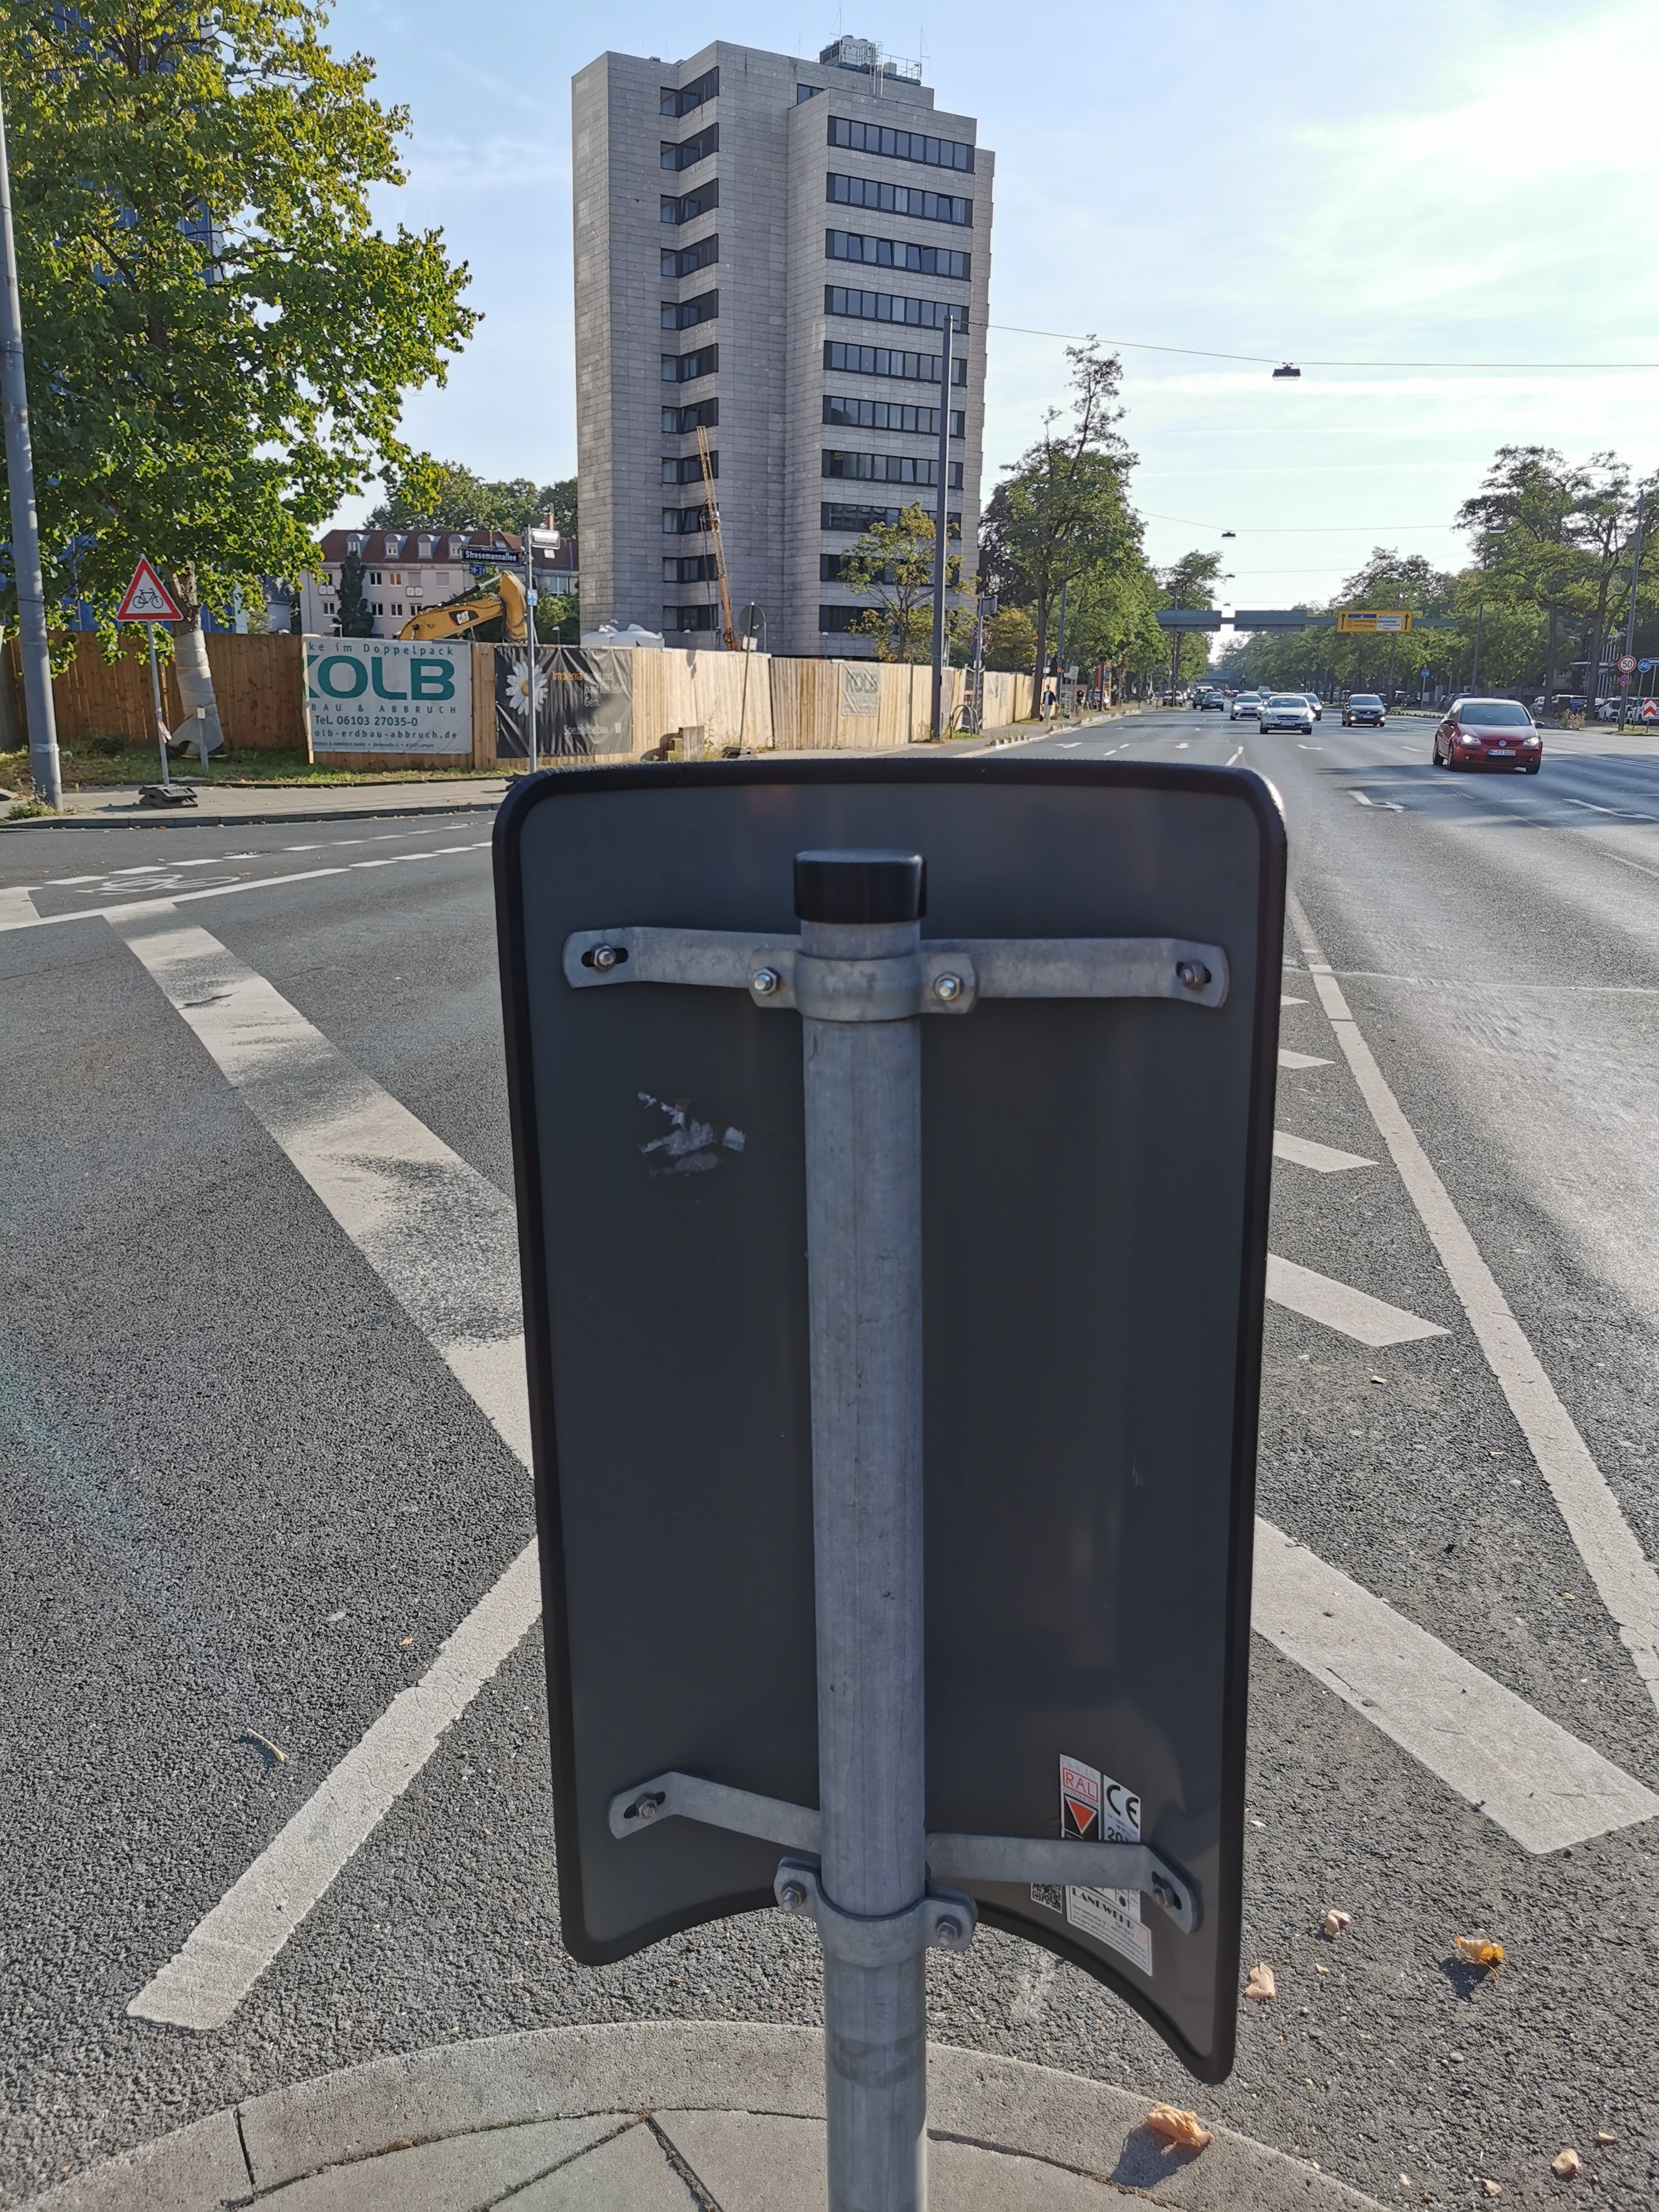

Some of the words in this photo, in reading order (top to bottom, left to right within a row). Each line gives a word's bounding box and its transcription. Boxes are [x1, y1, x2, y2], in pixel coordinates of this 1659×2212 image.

[465, 550, 517, 561] Stresemannallee
[456, 611, 470, 625] CAT
[335, 642, 352, 652] im
[363, 643, 454, 657] Doppelpack
[1622, 660, 1633, 668] 50
[357, 704, 364, 712] &
[379, 705, 456, 714] ABBRUCH
[315, 715, 333, 725] Tel.
[337, 716, 370, 726] 06103
[374, 716, 418, 726] 27035-0
[1065, 1771, 1096, 1799] RAL
[1106, 1784, 1139, 1829] CE
